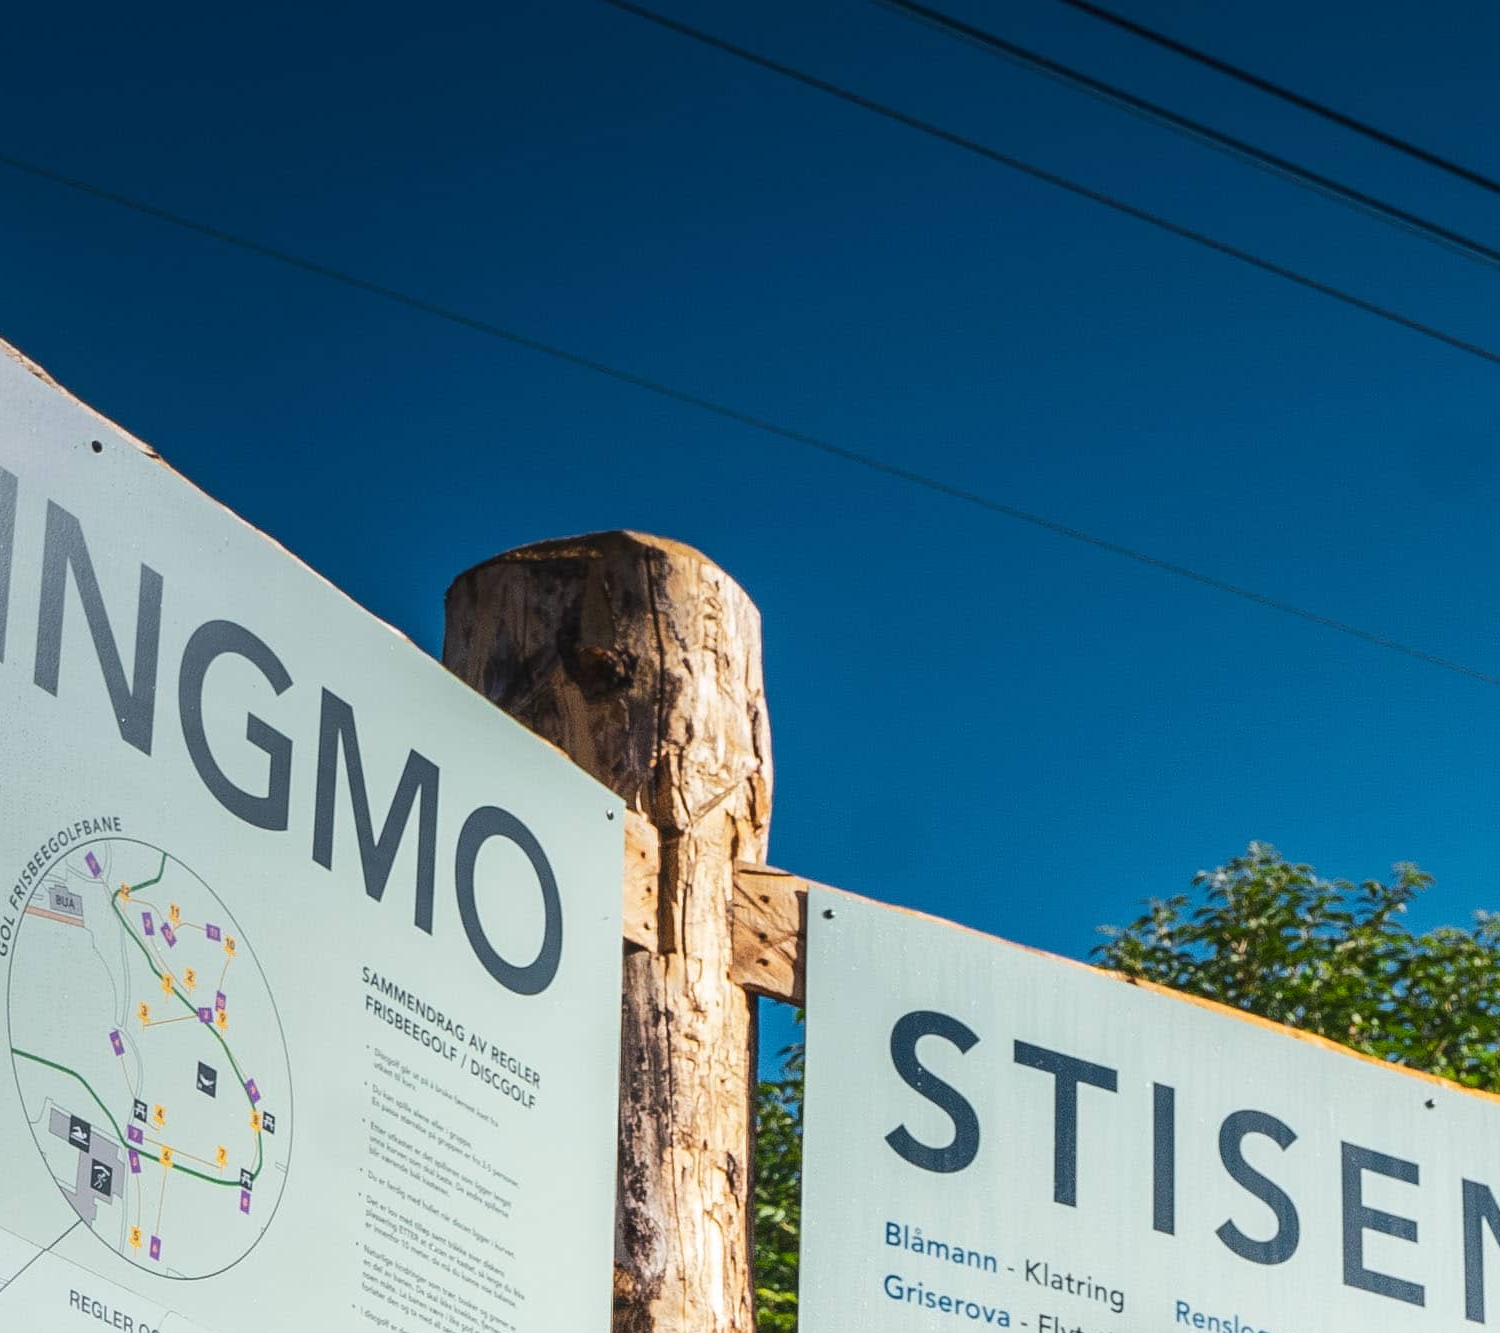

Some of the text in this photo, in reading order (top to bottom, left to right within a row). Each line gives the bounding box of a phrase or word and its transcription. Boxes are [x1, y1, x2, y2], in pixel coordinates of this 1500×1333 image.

[9, 816, 122, 911] FRISBEEGOLFBANE
[55, 895, 75, 910] BUA
[362, 966, 541, 1089] SAMMENDRAG AV REGLER
[365, 995, 457, 1062] FRISBEEGOLF
[471, 1059, 536, 1110] DISCGOLF
[883, 1275, 1012, 1329] Griserova
[884, 1222, 998, 1274] Blåmann
[1025, 1262, 1126, 1313] Klatring
